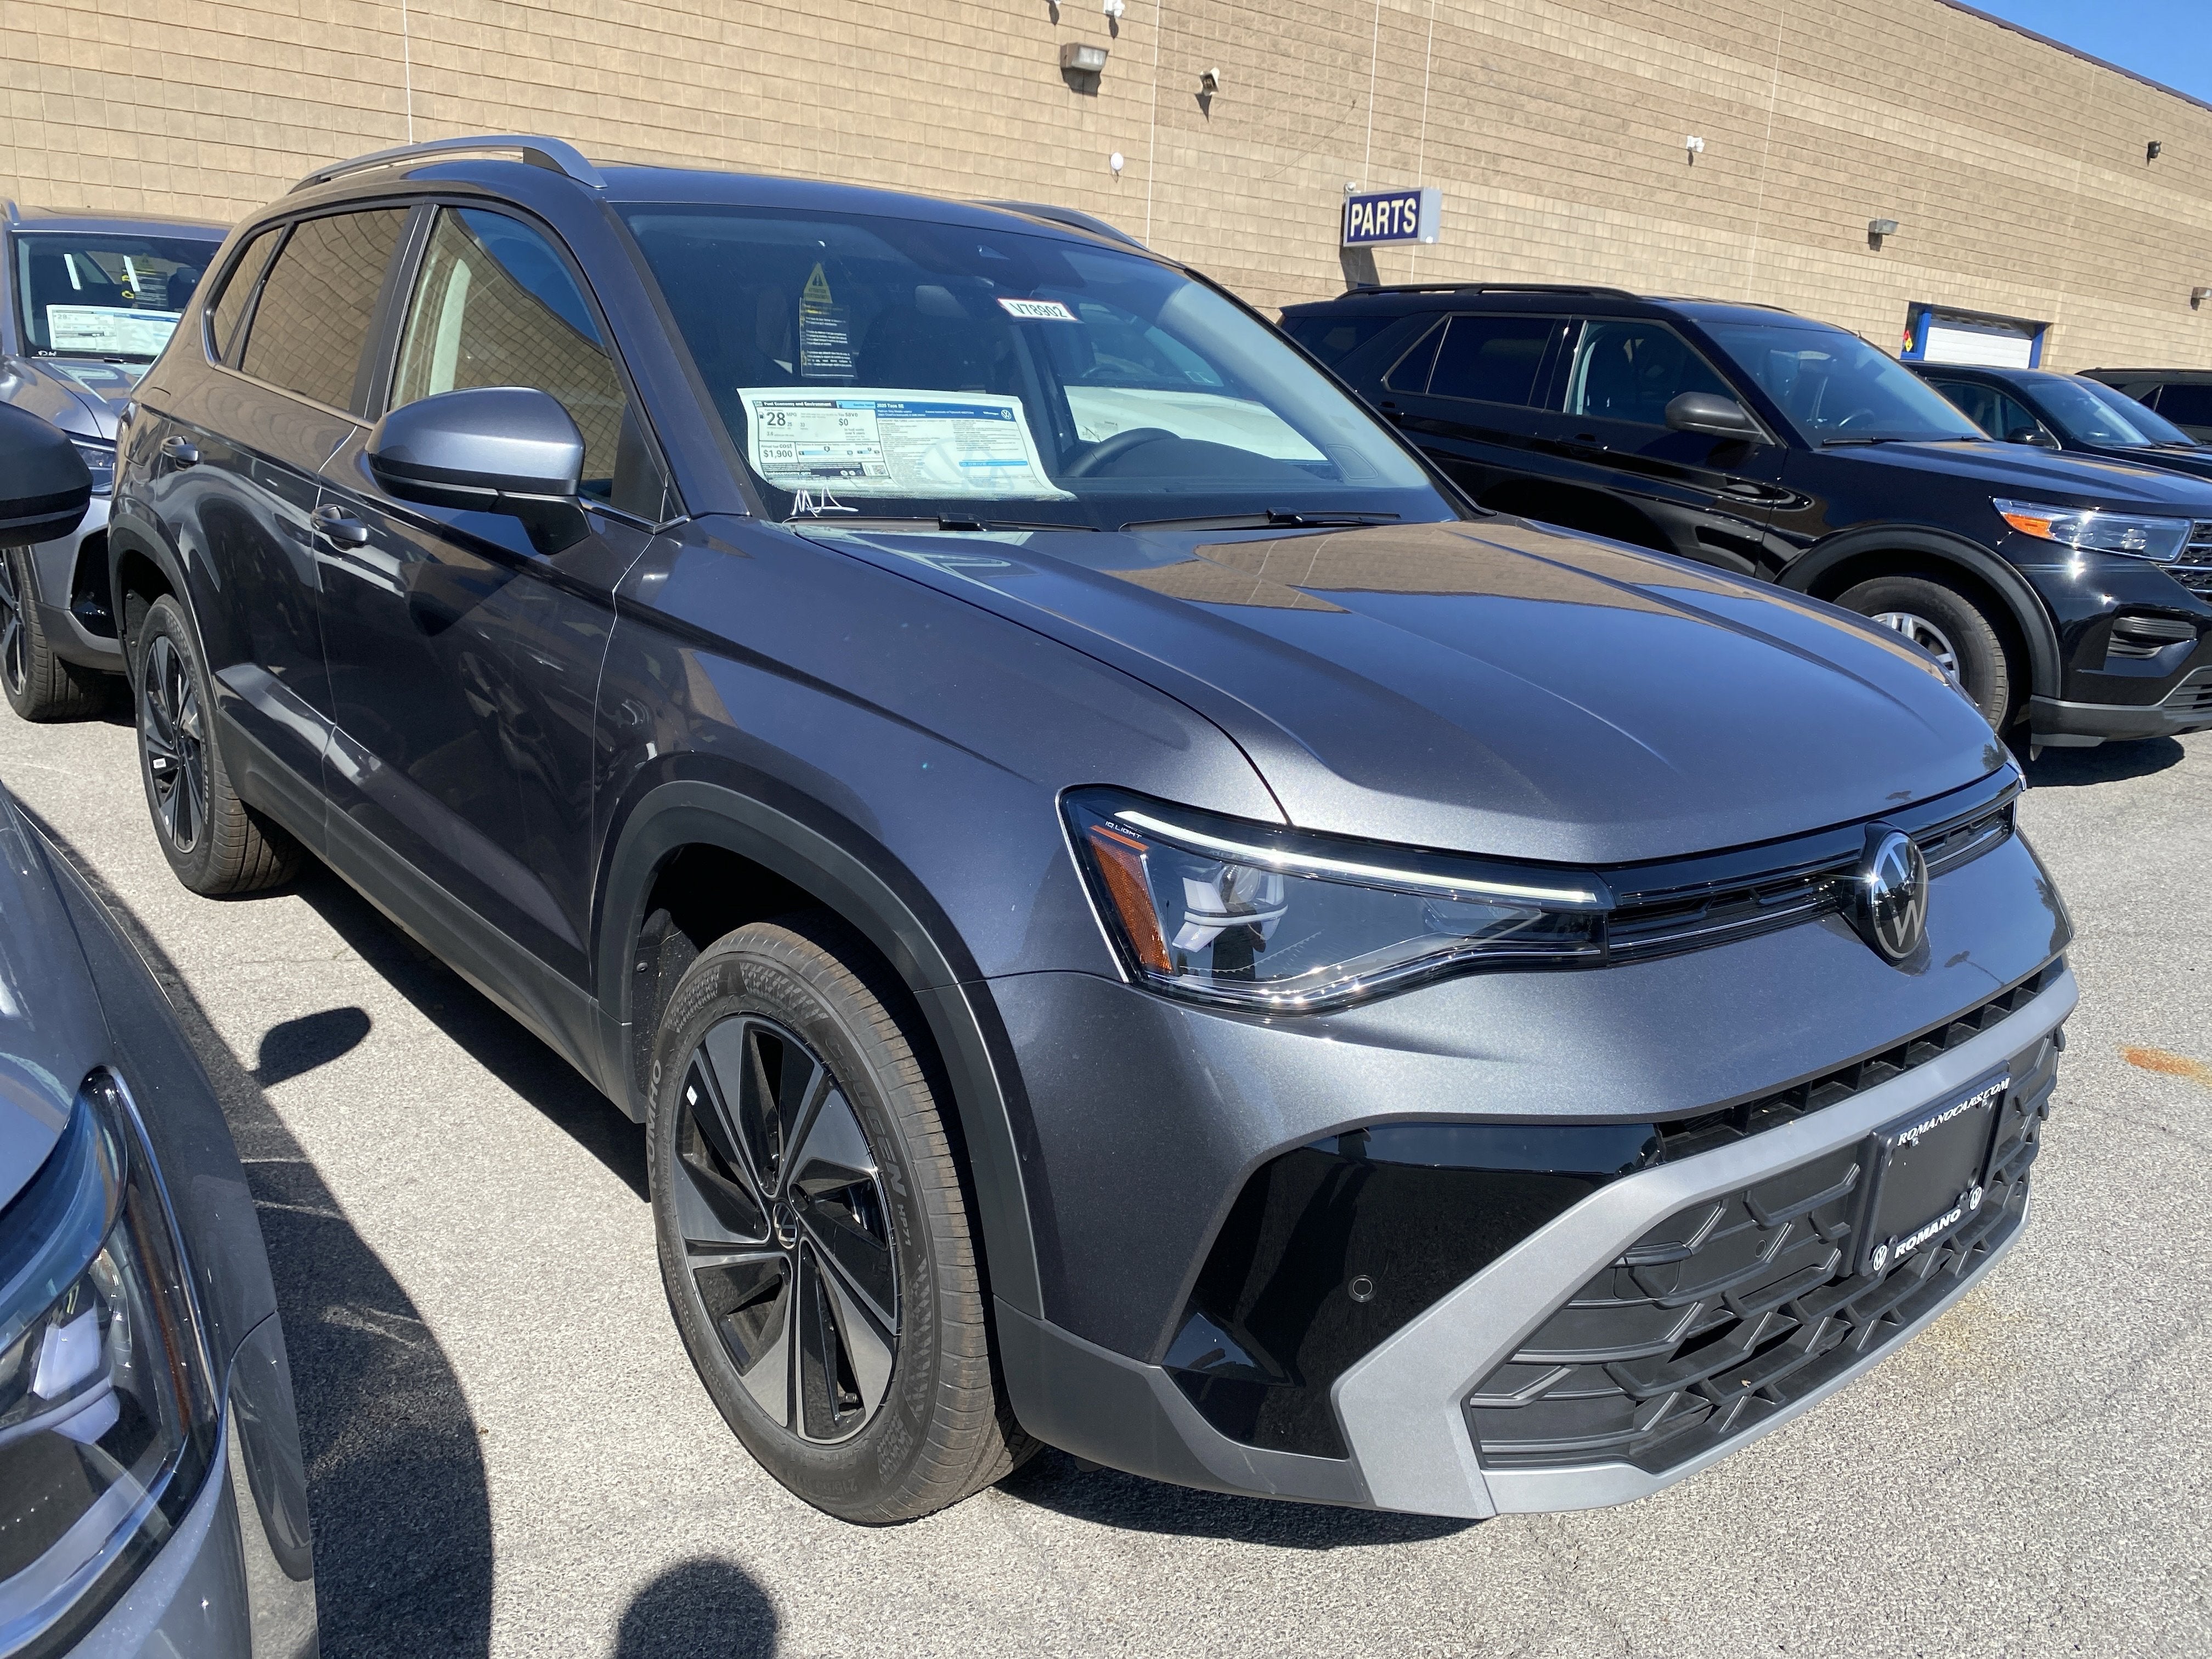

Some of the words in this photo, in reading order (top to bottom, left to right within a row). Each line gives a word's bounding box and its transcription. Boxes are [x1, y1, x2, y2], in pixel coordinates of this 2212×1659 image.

[1350, 198, 1417, 237] PARTS
[1008, 302, 1068, 318] V78902
[766, 412, 786, 426] 28
[838, 417, 848, 427] $0
[763, 449, 793, 459] $1,900
[1105, 821, 1142, 839] IQ.LIGHT
[646, 1059, 662, 1189] KUMHO
[825, 1039, 907, 1198] CRUGEN
[896, 1204, 911, 1247] HP71
[1894, 1209, 1961, 1259] ROMANO
